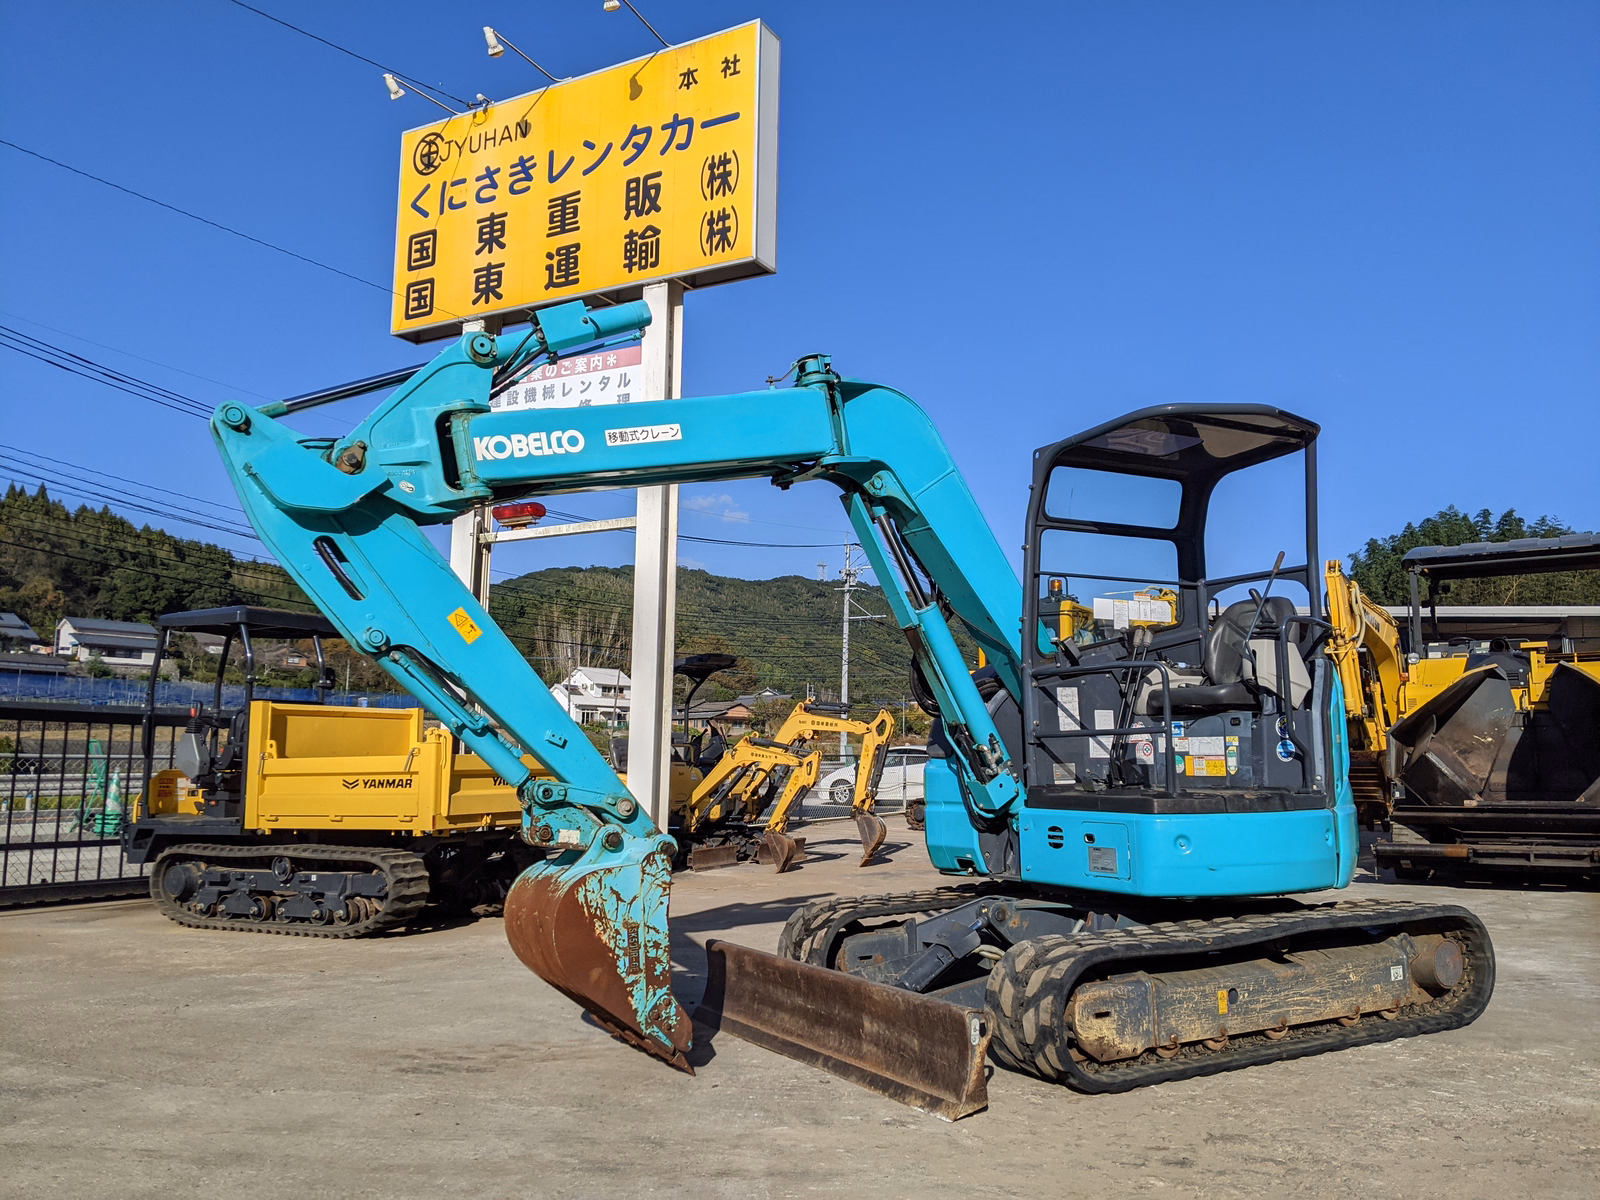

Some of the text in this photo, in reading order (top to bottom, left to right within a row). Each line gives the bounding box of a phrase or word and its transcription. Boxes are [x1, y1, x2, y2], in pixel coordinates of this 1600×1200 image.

[678, 53, 741, 90] 本社
[439, 119, 529, 162] JYUHAN
[410, 111, 741, 218] くにさきレンタカー
[472, 429, 586, 461] KOBELCO
[607, 427, 680, 443] 移動式クレーン
[362, 778, 413, 789] YANMAR
